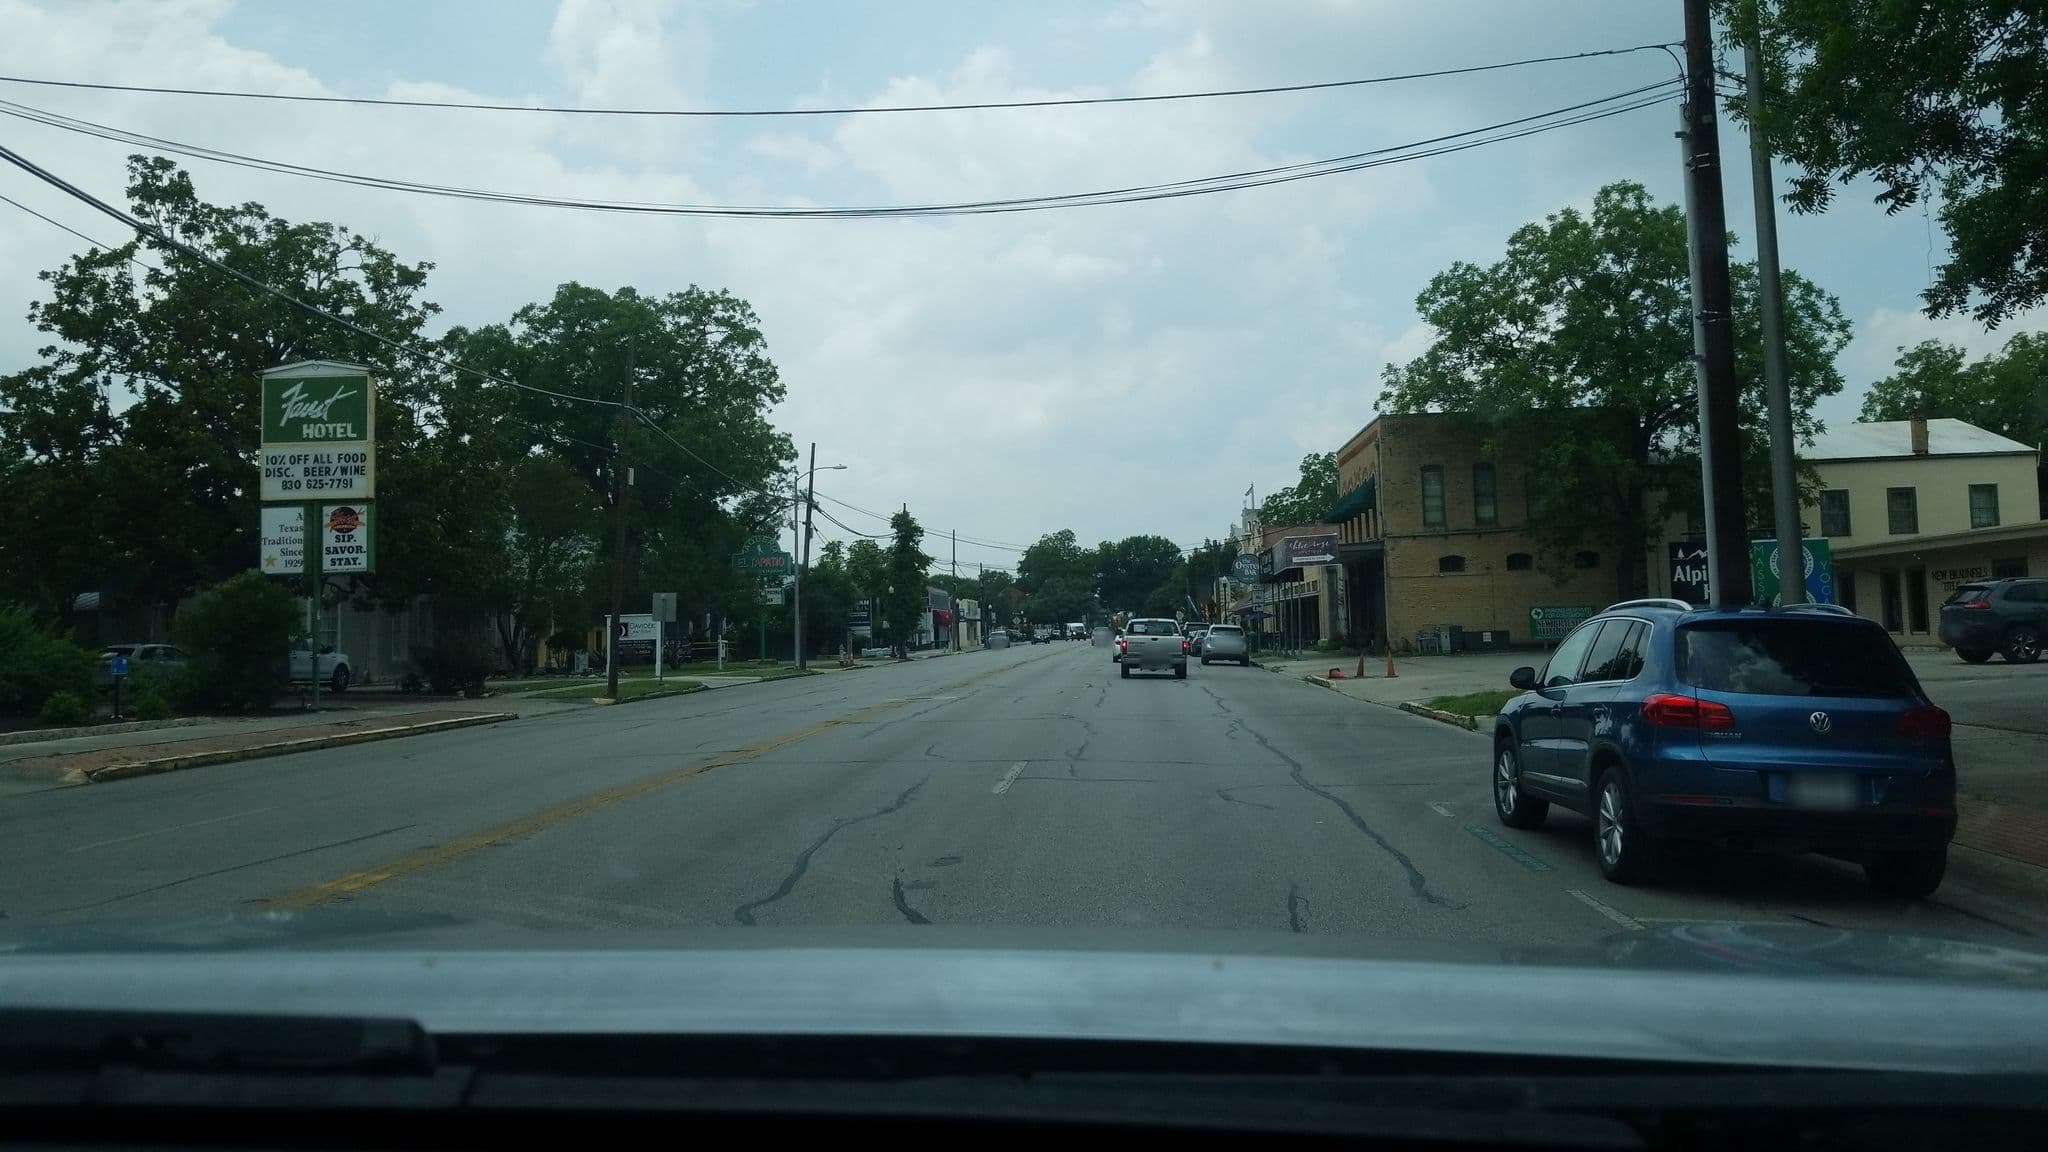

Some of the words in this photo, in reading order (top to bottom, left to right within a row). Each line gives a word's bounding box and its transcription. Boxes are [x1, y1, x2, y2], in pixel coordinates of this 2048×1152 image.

[279, 381, 358, 427] Faust
[302, 422, 358, 439] HOTEL
[265, 455, 286, 465] 10%
[289, 454, 309, 465] OFF
[313, 453, 333, 464] ALL
[337, 452, 367, 463] FOOD
[265, 466, 294, 478] DISC.
[303, 465, 366, 477] BEER/WINE
[306, 478, 353, 489] 625-7791
[296, 513, 304, 521] A
[279, 524, 304, 532] Texas
[262, 537, 304, 545] Tradition
[335, 534, 357, 543] SIP.
[280, 548, 304, 557] Since
[325, 545, 367, 555] SAVOR.
[284, 559, 304, 568] 1929
[330, 557, 362, 566] STAY.
[1673, 565, 1708, 586] Alpi
